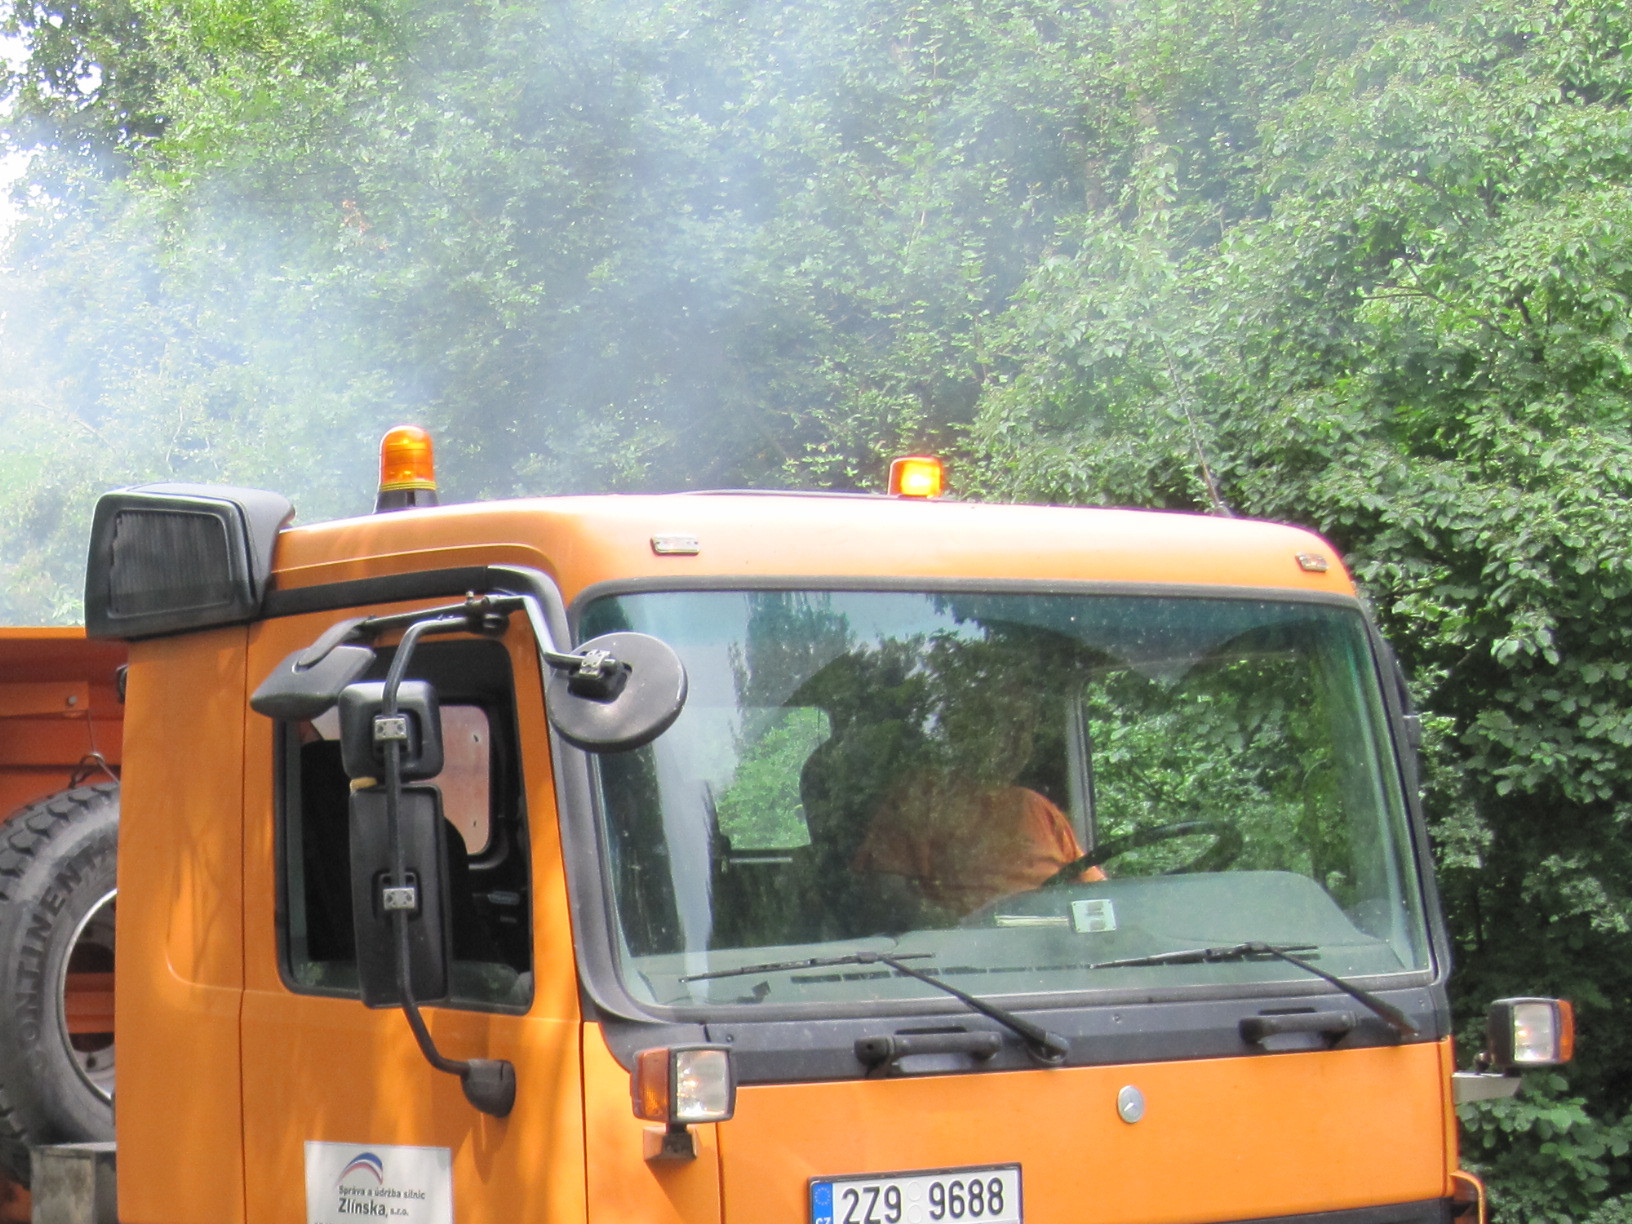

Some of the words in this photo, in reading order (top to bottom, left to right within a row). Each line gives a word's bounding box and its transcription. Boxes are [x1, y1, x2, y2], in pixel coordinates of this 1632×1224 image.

[16, 833, 117, 1072] CONTINENTA
[338, 1197, 388, 1218] Zlínska,
[339, 1185, 365, 1196] Správa
[368, 1188, 373, 1196] a
[375, 1187, 401, 1198] údržba
[404, 1189, 425, 1200] silnic
[928, 1177, 1004, 1220] 9688
